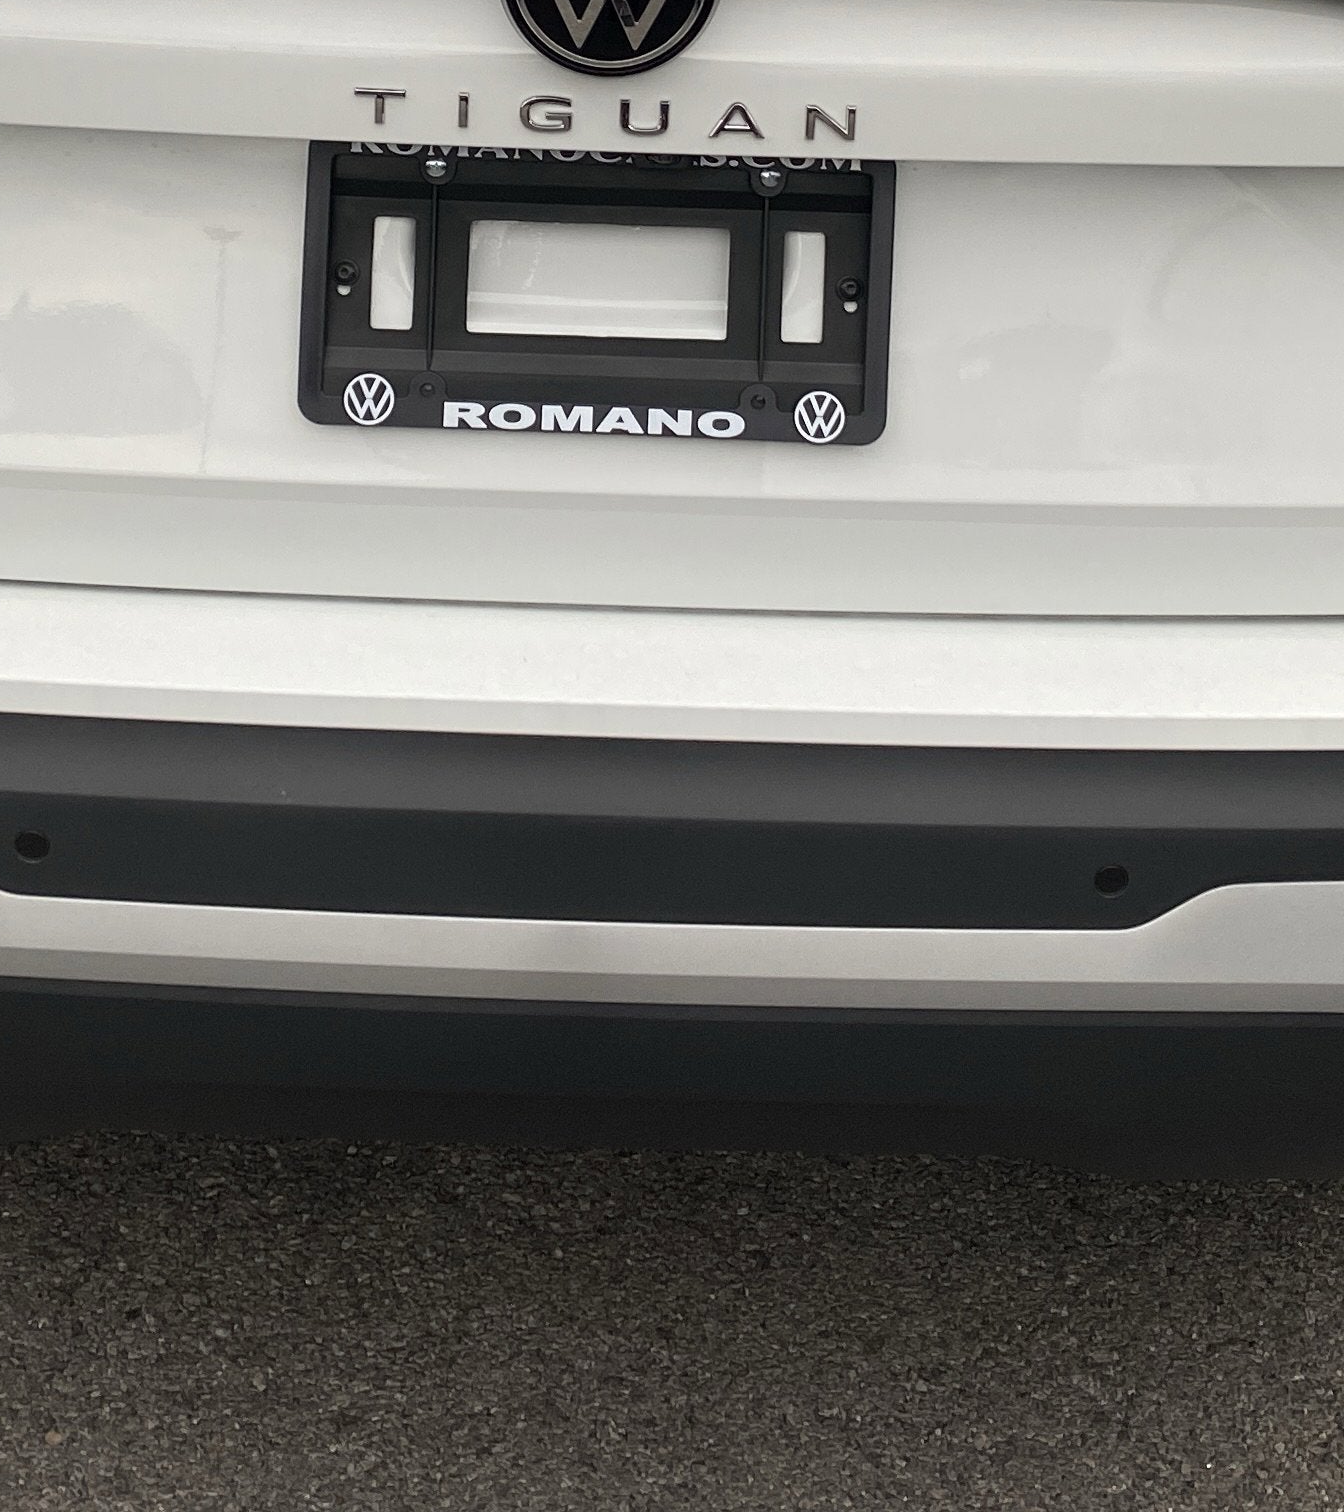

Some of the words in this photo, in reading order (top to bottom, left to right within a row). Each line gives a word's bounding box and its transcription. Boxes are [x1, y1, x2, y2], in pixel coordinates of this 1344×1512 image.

[354, 86, 858, 142] TIGUAN
[344, 373, 395, 426] VW
[442, 400, 746, 439] ROMANO
[793, 390, 846, 444] VW
